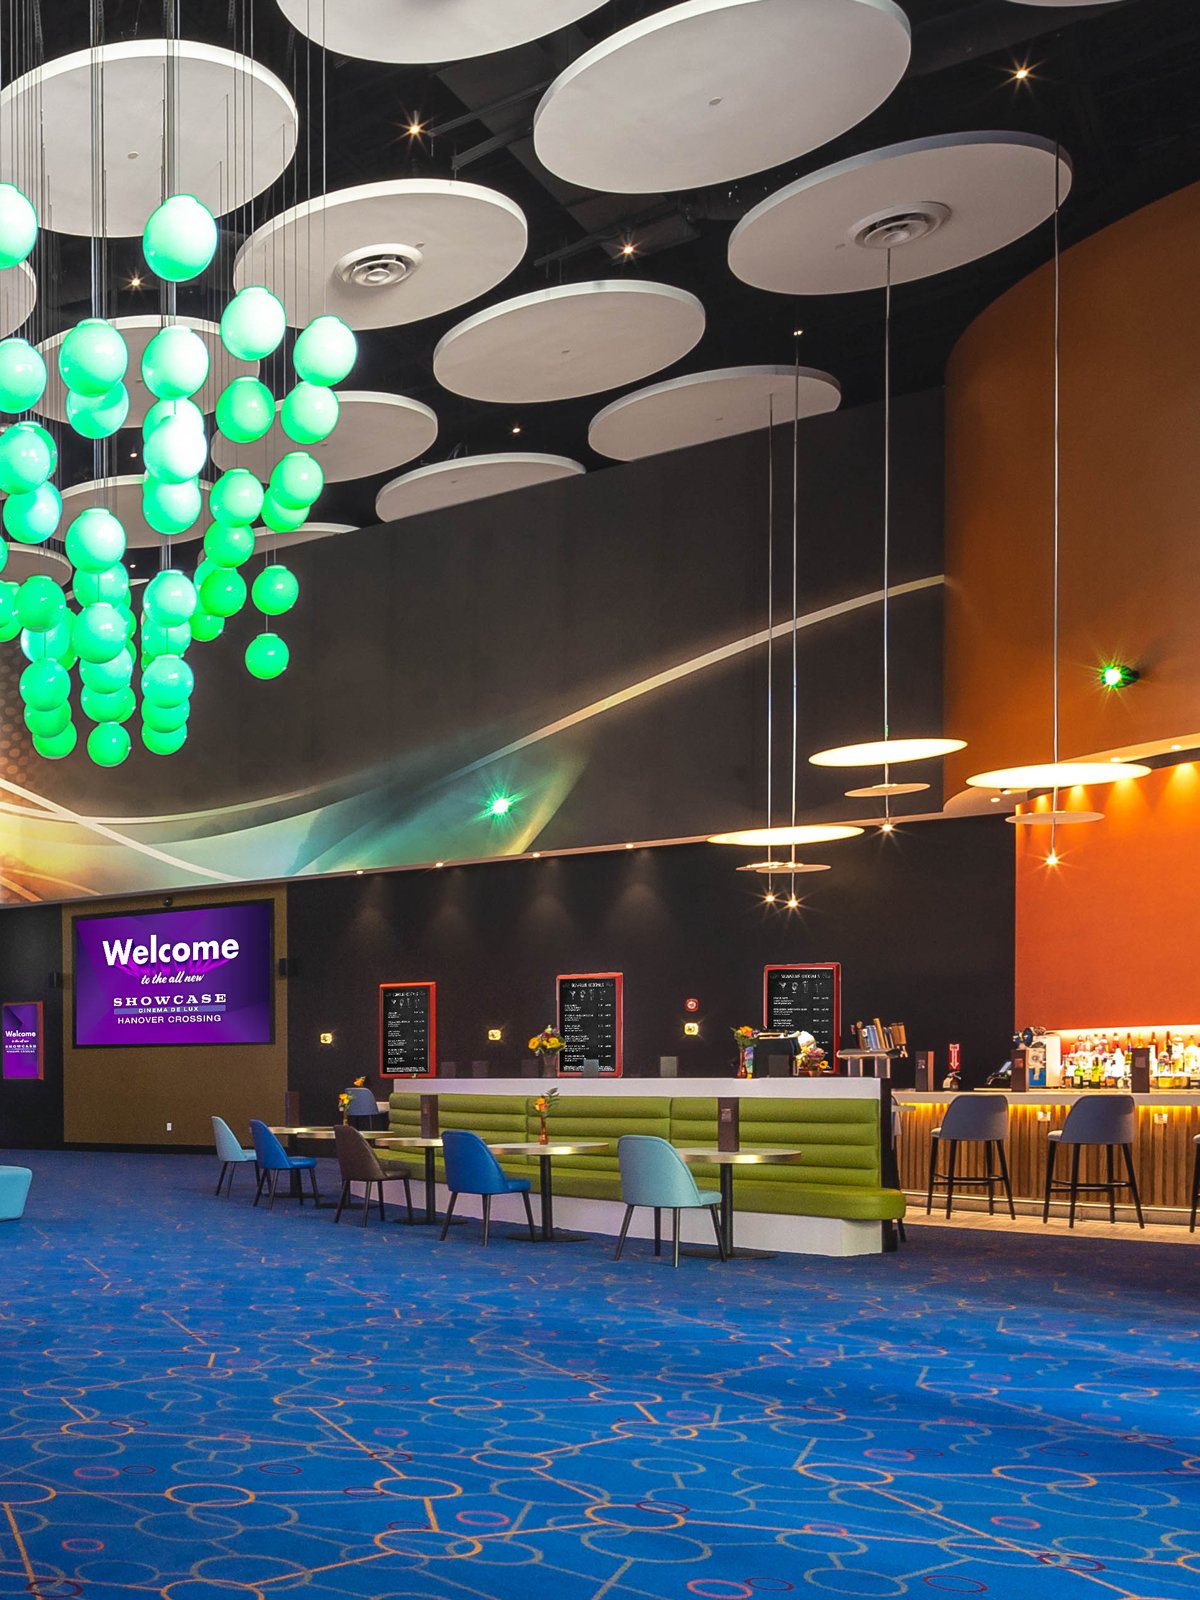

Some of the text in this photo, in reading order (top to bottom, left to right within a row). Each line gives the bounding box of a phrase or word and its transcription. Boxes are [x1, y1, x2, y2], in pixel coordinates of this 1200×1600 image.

[102, 934, 240, 966] Welcome
[141, 970, 205, 985] to the all new
[113, 993, 227, 1007] SHOWCASE
[138, 1006, 168, 1014] CINEMA
[117, 1014, 221, 1025] HANOVER CROSSING
